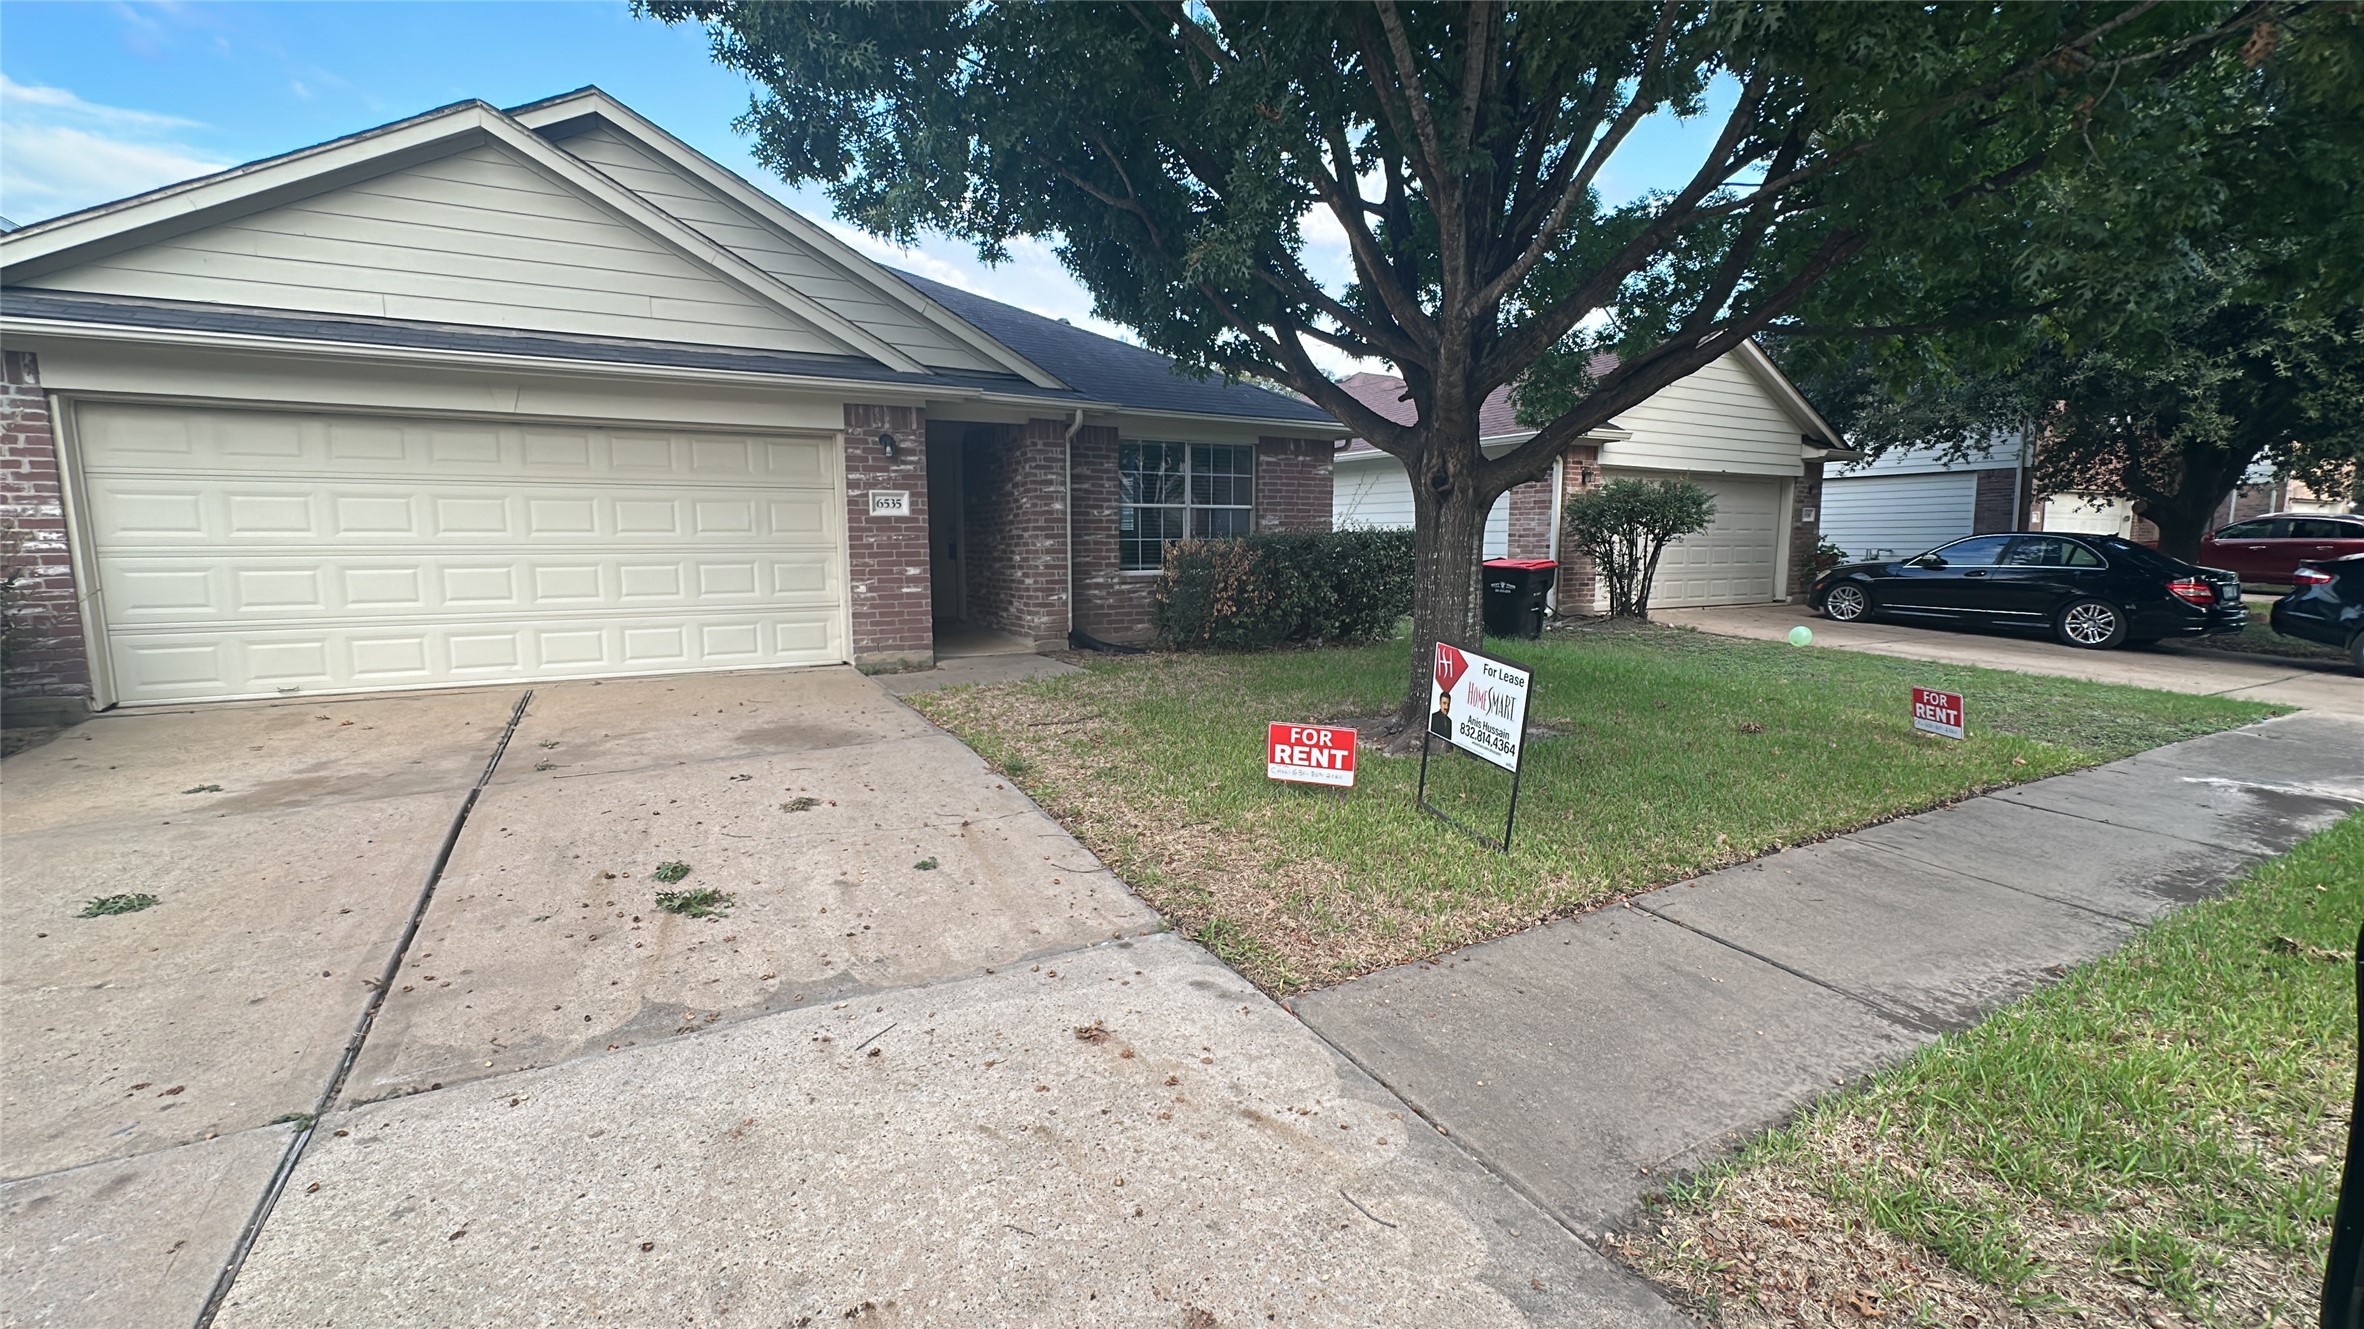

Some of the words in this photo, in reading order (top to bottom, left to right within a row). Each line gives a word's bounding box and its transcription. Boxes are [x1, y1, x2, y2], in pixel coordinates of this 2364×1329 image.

[876, 498, 902, 509] 6535
[1483, 663, 1498, 678] For
[1499, 668, 1525, 688] Lease
[1923, 691, 1948, 707] FOR
[1915, 702, 1958, 725] RENT
[1290, 727, 1333, 747] FOR
[1460, 722, 1516, 757] 832.814.4364
[1467, 715, 1482, 729] Anis
[1482, 720, 1510, 740] Hussain
[1274, 743, 1349, 769] RENT
